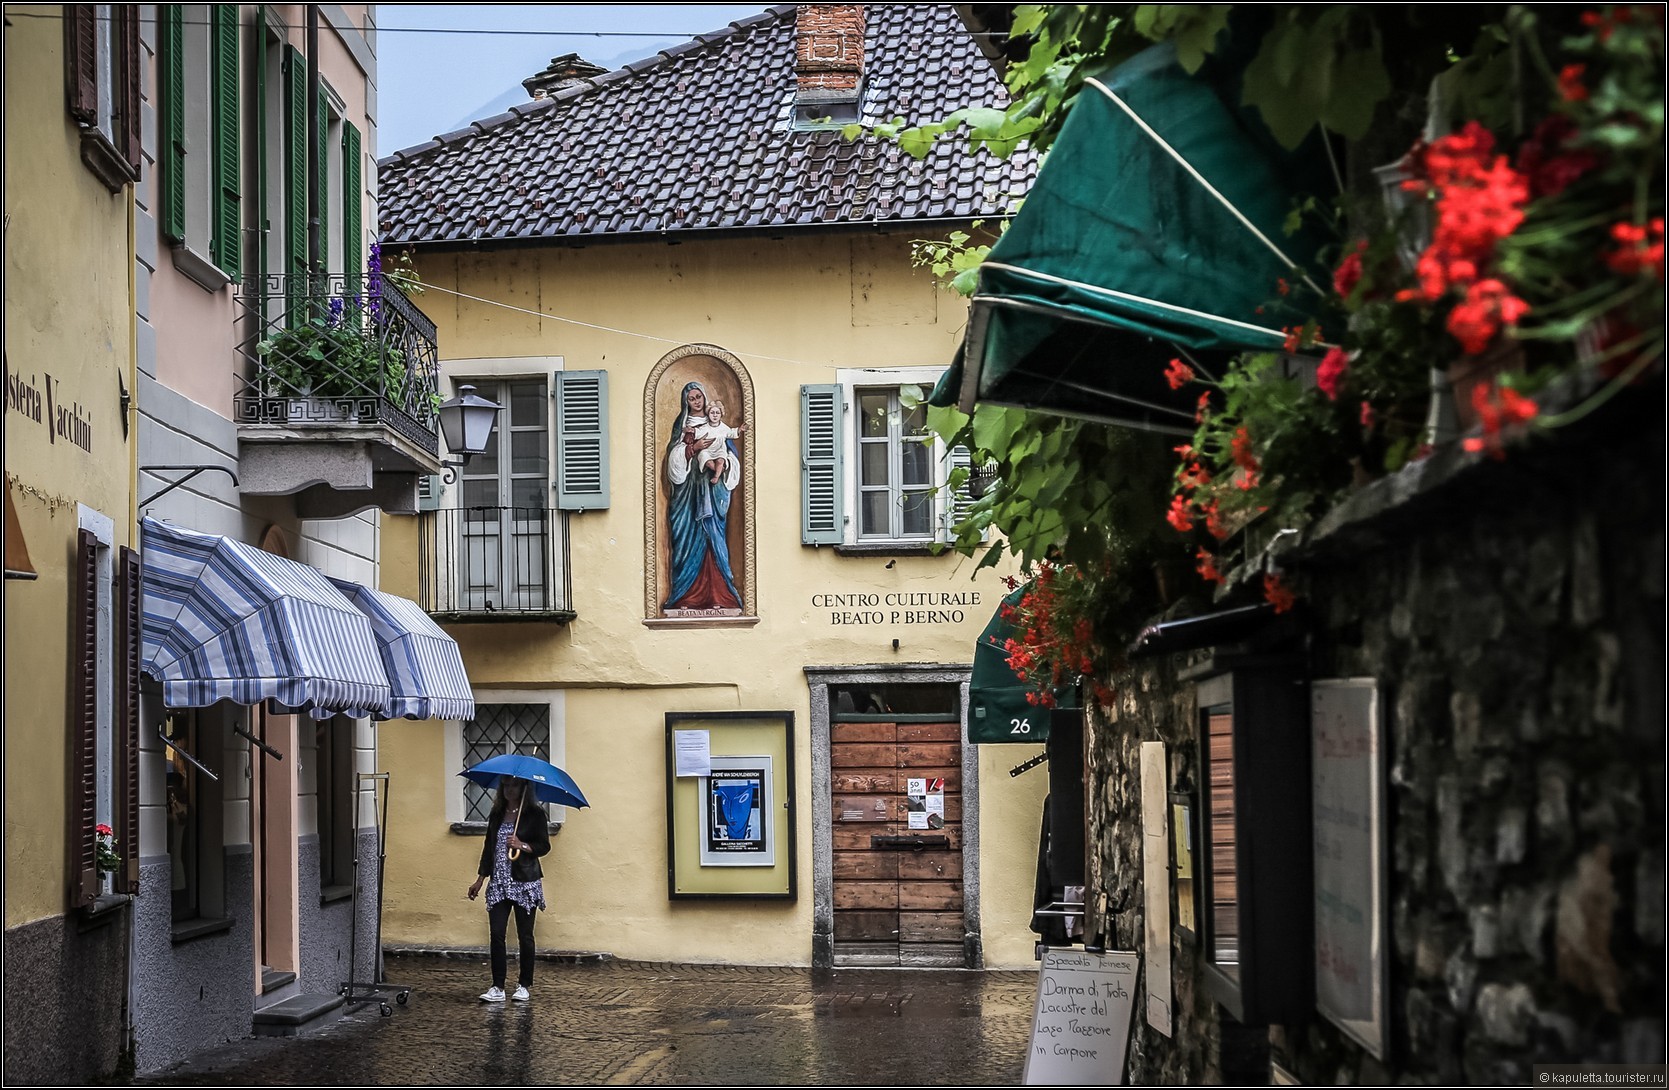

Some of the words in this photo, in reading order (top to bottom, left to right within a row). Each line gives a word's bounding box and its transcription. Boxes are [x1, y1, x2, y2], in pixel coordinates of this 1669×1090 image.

[44, 372, 91, 454] Vacchini
[812, 594, 879, 607] CENTRO
[885, 592, 981, 606] CULTURALE
[831, 611, 884, 625] BEATO
[890, 611, 900, 624] P.
[904, 610, 964, 624] BERNO
[1010, 718, 1031, 734] 26
[1088, 980, 1099, 997] di
[1101, 980, 1129, 1000] Trota
[1041, 995, 1087, 1015] Lacustre
[1090, 1000, 1108, 1017] del
[1034, 1041, 1047, 1056] in
[1053, 1043, 1098, 1062] Carpione
